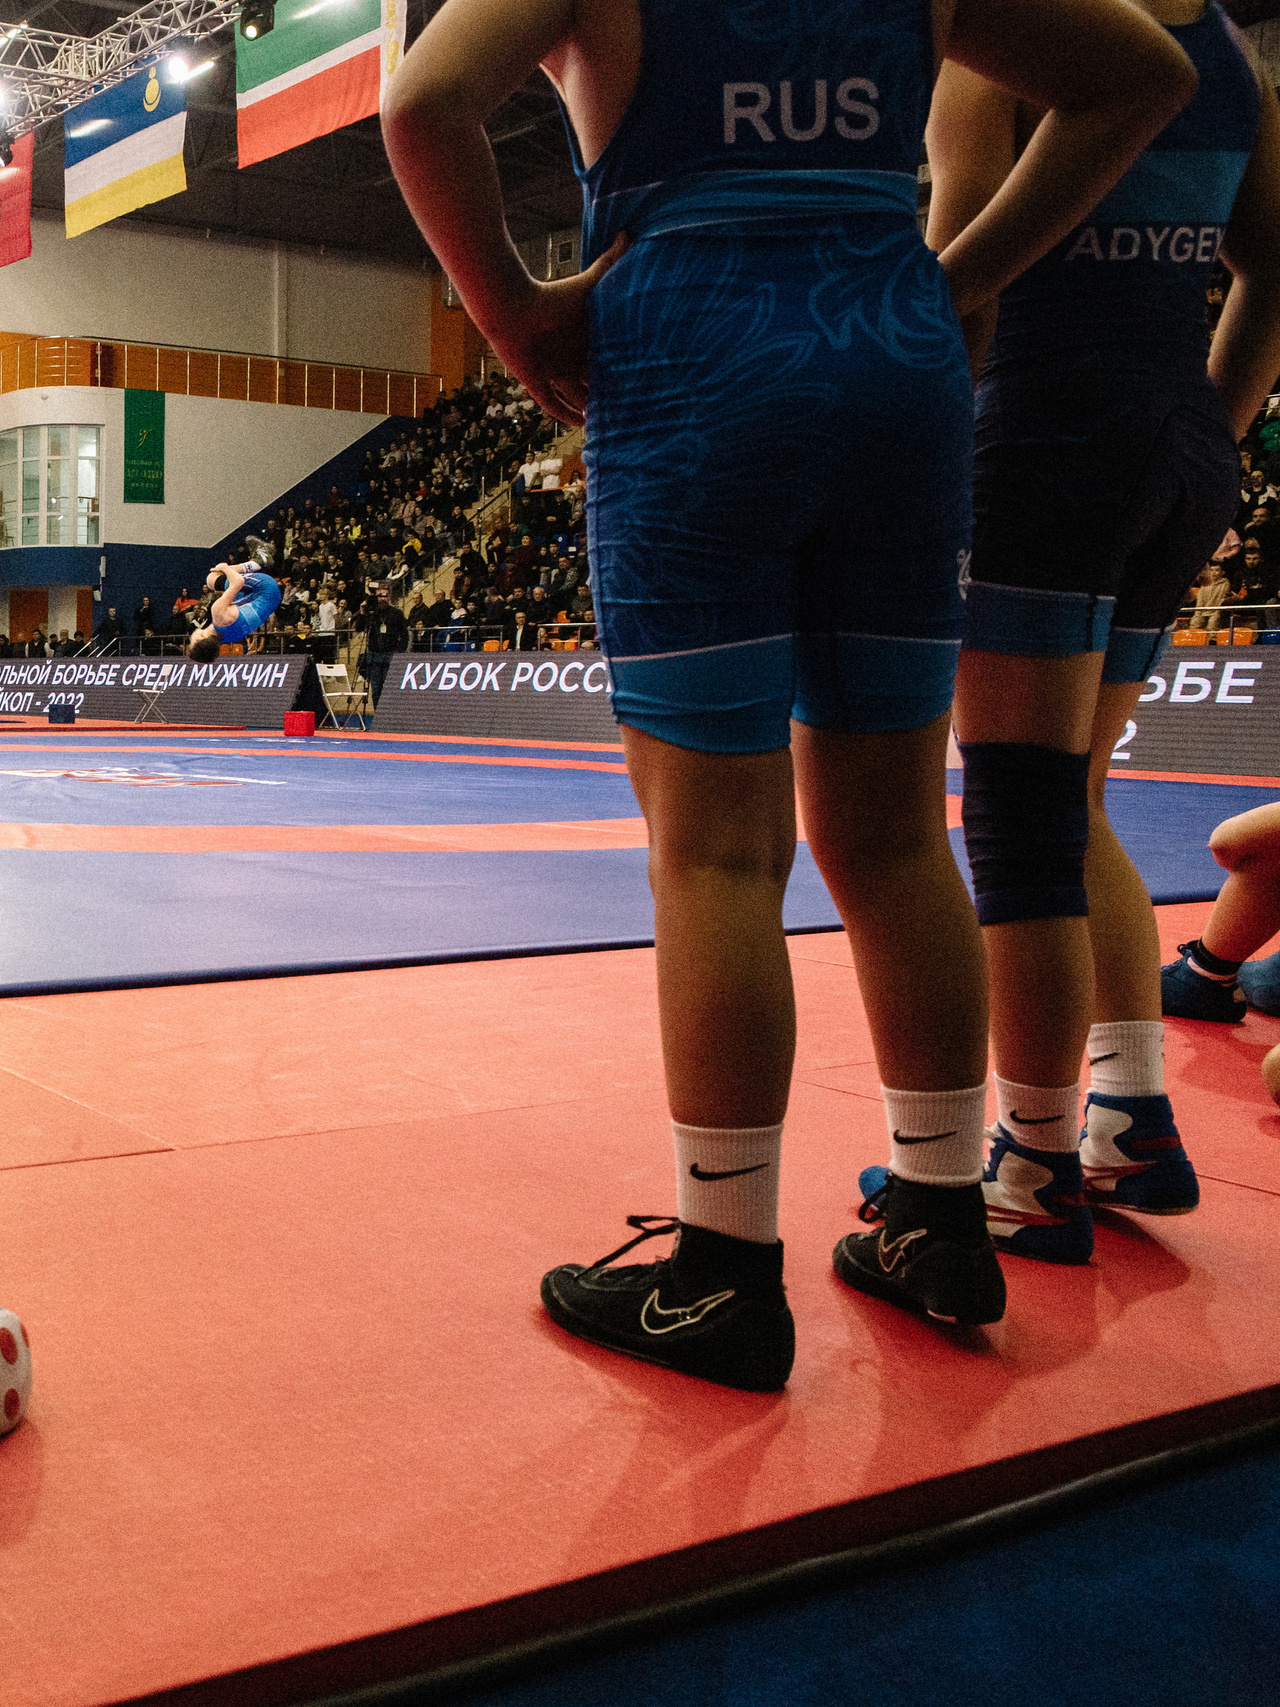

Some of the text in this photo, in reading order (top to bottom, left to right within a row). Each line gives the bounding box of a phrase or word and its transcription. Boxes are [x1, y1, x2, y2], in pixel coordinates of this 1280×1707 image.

[723, 76, 880, 144] RUS
[51, 664, 120, 686] БОРЬБЕ
[187, 663, 289, 688] МУЖЧИН
[400, 661, 613, 693] КУБОК РОСС
